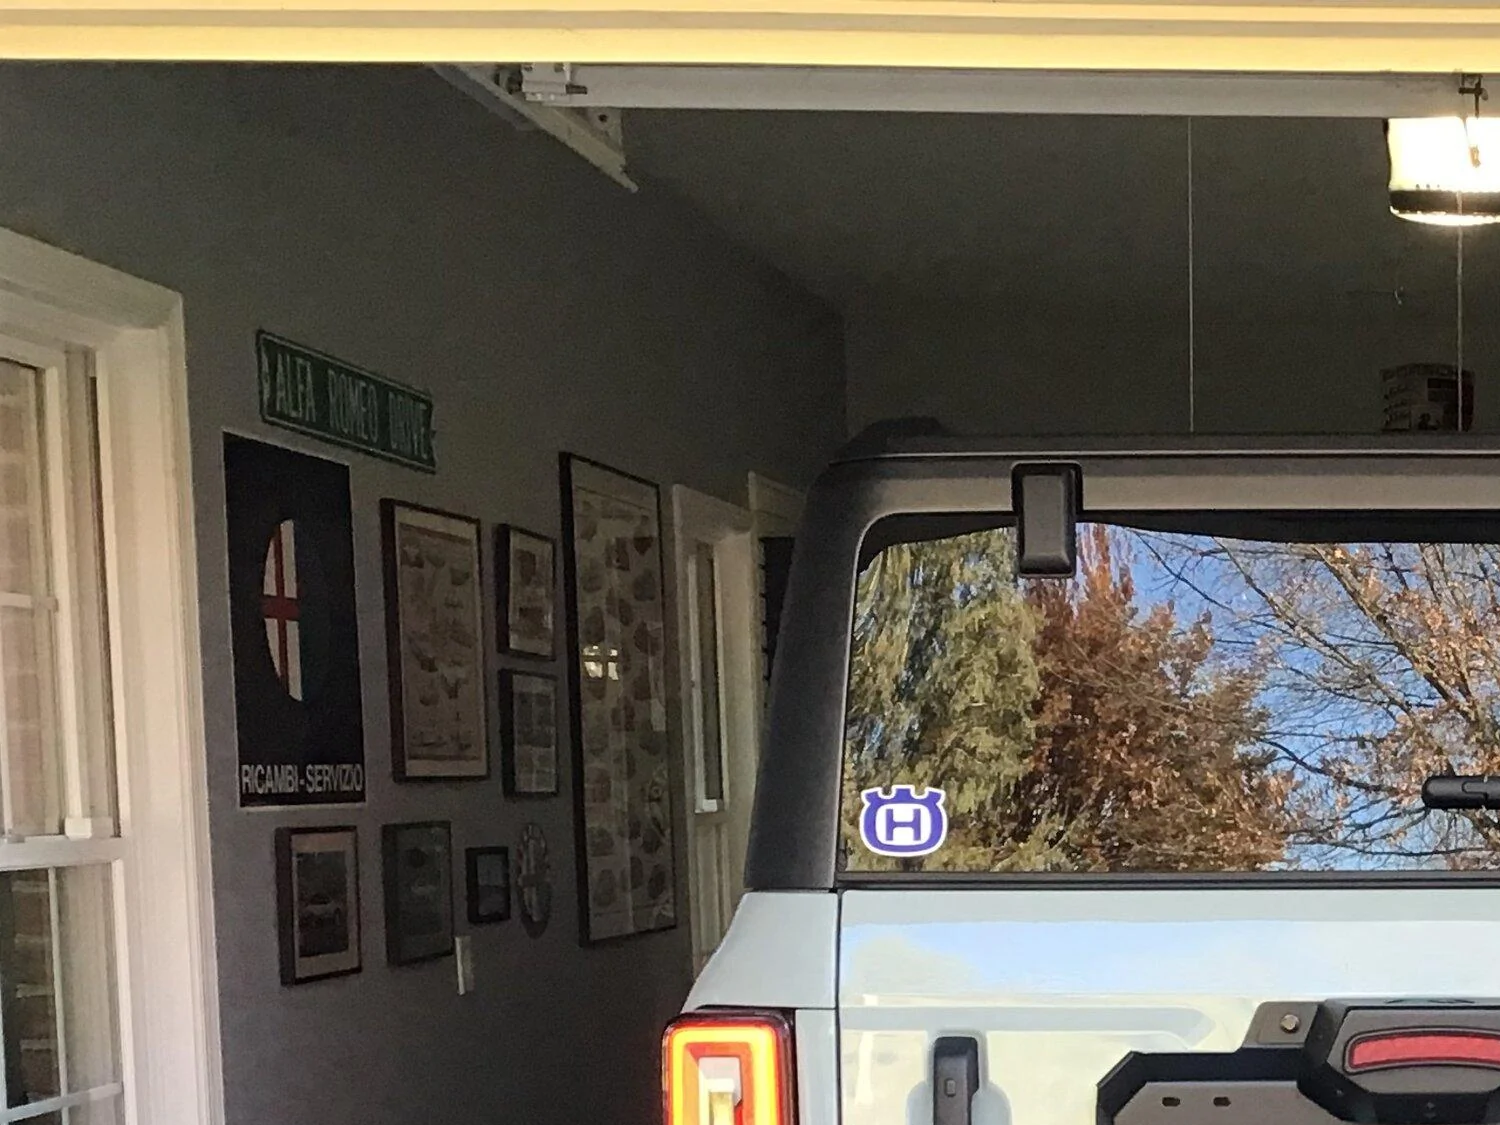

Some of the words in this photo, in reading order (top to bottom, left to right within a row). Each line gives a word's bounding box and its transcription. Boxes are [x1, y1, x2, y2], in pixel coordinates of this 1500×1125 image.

[276, 352, 316, 423] ALFA
[328, 367, 378, 443] ROMEO
[388, 390, 429, 461] DRIVE
